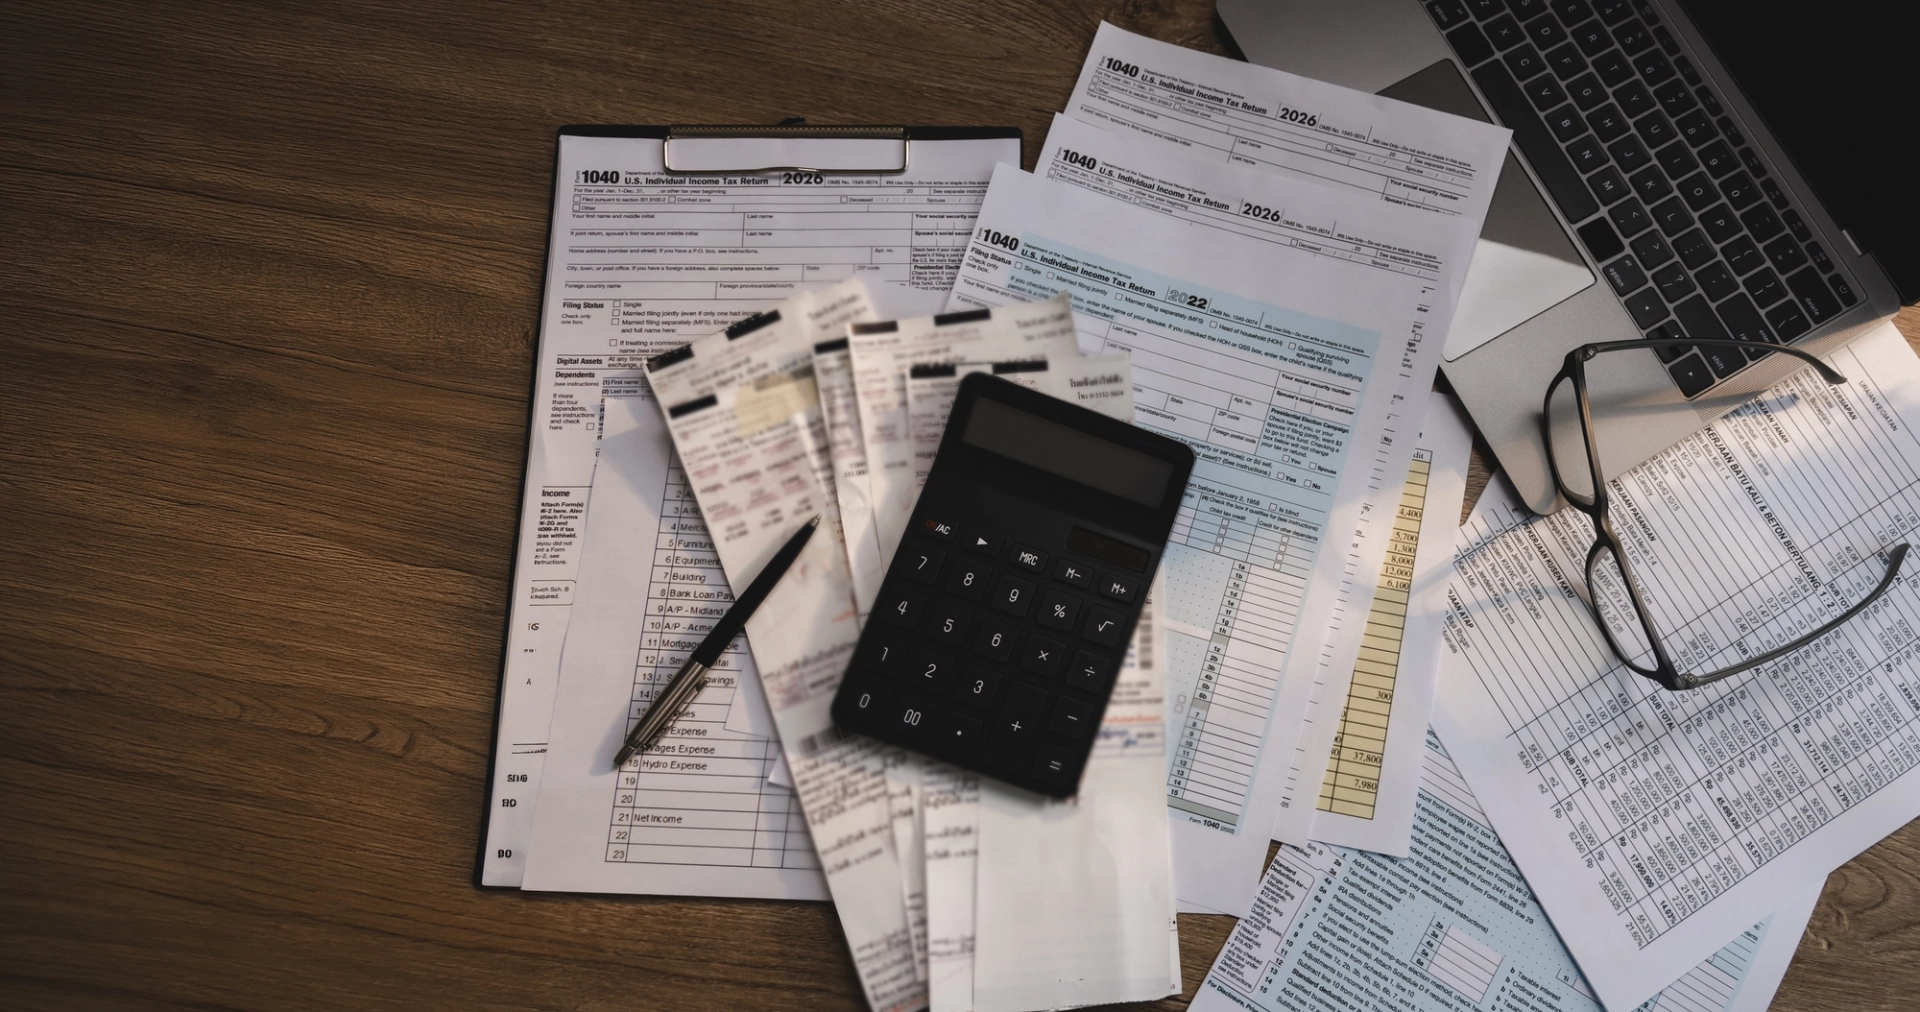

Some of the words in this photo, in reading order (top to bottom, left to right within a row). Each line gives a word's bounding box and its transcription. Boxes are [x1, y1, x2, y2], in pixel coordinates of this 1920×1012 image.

[1500, 28, 1509, 36] X
[1541, 27, 1550, 35] D
[1106, 58, 1140, 78] 1040
[1141, 74, 1156, 85] U.S.
[1158, 79, 1196, 96] Individual
[1195, 89, 1224, 103] Income
[1226, 97, 1240, 108] Tax
[1241, 102, 1267, 115] Return
[1279, 107, 1317, 127] 2026
[1562, 120, 1570, 128] B
[1603, 118, 1613, 128] H
[1062, 149, 1097, 170] 1040
[1583, 150, 1592, 159] N
[582, 170, 620, 184] 1040
[624, 177, 642, 185] U.S.
[645, 177, 686, 185] Individual
[688, 177, 720, 185] Income
[722, 177, 738, 185] Tax
[740, 177, 769, 185] Return
[782, 172, 825, 185] 2026
[1099, 167, 1115, 178] U.S.
[1117, 172, 1156, 190] Individual
[1156, 184, 1186, 198] Income
[1187, 193, 1202, 203] Tax
[1203, 197, 1230, 211] Return
[1603, 181, 1613, 190] M
[1241, 203, 1281, 222] 2026
[1716, 219, 1725, 227] P
[983, 229, 1020, 251] 1040
[968, 255, 986, 266] Check
[986, 262, 999, 270] only
[970, 246, 990, 259] Filing
[990, 253, 1012, 266] Status
[976, 265, 989, 274] box.
[1021, 249, 1038, 260] U.S.
[1040, 255, 1079, 273] Individual
[1080, 267, 1110, 282] Income
[1112, 276, 1127, 288] Tax
[1128, 282, 1156, 297] Return
[1024, 265, 1042, 275] Single
[1609, 267, 1624, 287] option
[564, 282, 585, 290] Foreign
[1055, 275, 1078, 286] Married
[1077, 282, 1092, 292] filing
[1090, 287, 1108, 296] jointly
[562, 301, 582, 310] Filing
[582, 301, 605, 309] Status
[1168, 289, 1208, 310] 2022
[1805, 297, 1820, 316] delete
[556, 357, 580, 366] Digital
[580, 357, 603, 365] Assets
[1712, 354, 1725, 370] shift
[555, 371, 596, 379] Dependents
[1874, 402, 1898, 432] KEGIATAN
[1772, 422, 1789, 444] TANAH
[541, 489, 571, 497] Income
[925, 518, 950, 536] ON/AC
[1630, 507, 1657, 542] PASANGAN
[1730, 462, 1749, 486] BATU
[1746, 483, 1763, 505] KALI
[1763, 508, 1790, 540] BETON
[1783, 539, 1825, 591] BERTULANG,
[678, 539, 713, 549] Furniture
[675, 556, 720, 566] Equipment
[918, 556, 928, 570] 7
[1019, 551, 1038, 566] MRC
[1521, 522, 1549, 559] PEKERJAAN
[1545, 558, 1563, 581] KUSEN
[1559, 580, 1575, 598] KAYU
[672, 572, 706, 584] Building
[963, 572, 974, 586] 8
[670, 589, 691, 598] Bank
[693, 590, 715, 599] Loan
[1009, 588, 1019, 603] 9
[1111, 583, 1126, 594] M+
[666, 605, 683, 613] A/P
[690, 606, 723, 616] Midland
[898, 601, 908, 615] 4
[1054, 604, 1066, 618] %
[943, 618, 954, 633] 5
[1459, 611, 1474, 628] ATAP
[650, 622, 661, 630] 10
[664, 622, 681, 630] A/P
[687, 623, 713, 633] Acme
[991, 633, 1002, 647] 6
[882, 647, 889, 661] 1
[924, 664, 937, 678] 2
[973, 680, 984, 694] 3
[859, 693, 871, 708] 0
[903, 708, 922, 726] 00
[1649, 695, 1662, 710] SUB
[1660, 709, 1676, 732] TOTAL
[671, 726, 707, 736] Expense
[1803, 740, 1829, 773] 31,712,114
[628, 759, 639, 767] 18
[642, 760, 668, 770] Hydro
[670, 760, 708, 771] Expense
[625, 777, 636, 785] 19
[621, 795, 633, 804] 20
[618, 813, 629, 822] 21
[634, 814, 650, 822] Net
[650, 814, 683, 824] Income
[1717, 797, 1741, 830] 45,498,930
[1203, 819, 1220, 830] 1040
[615, 831, 628, 840] 22
[612, 850, 625, 859] 23
[1630, 854, 1655, 888] 17,950,000
[1332, 894, 1358, 914] Pensions
[1357, 910, 1370, 921] and
[1368, 917, 1394, 936] annuities
[1327, 903, 1346, 918] Social
[1344, 915, 1367, 932] security
[1366, 927, 1389, 945] benefits
[1260, 986, 1268, 994] 15
